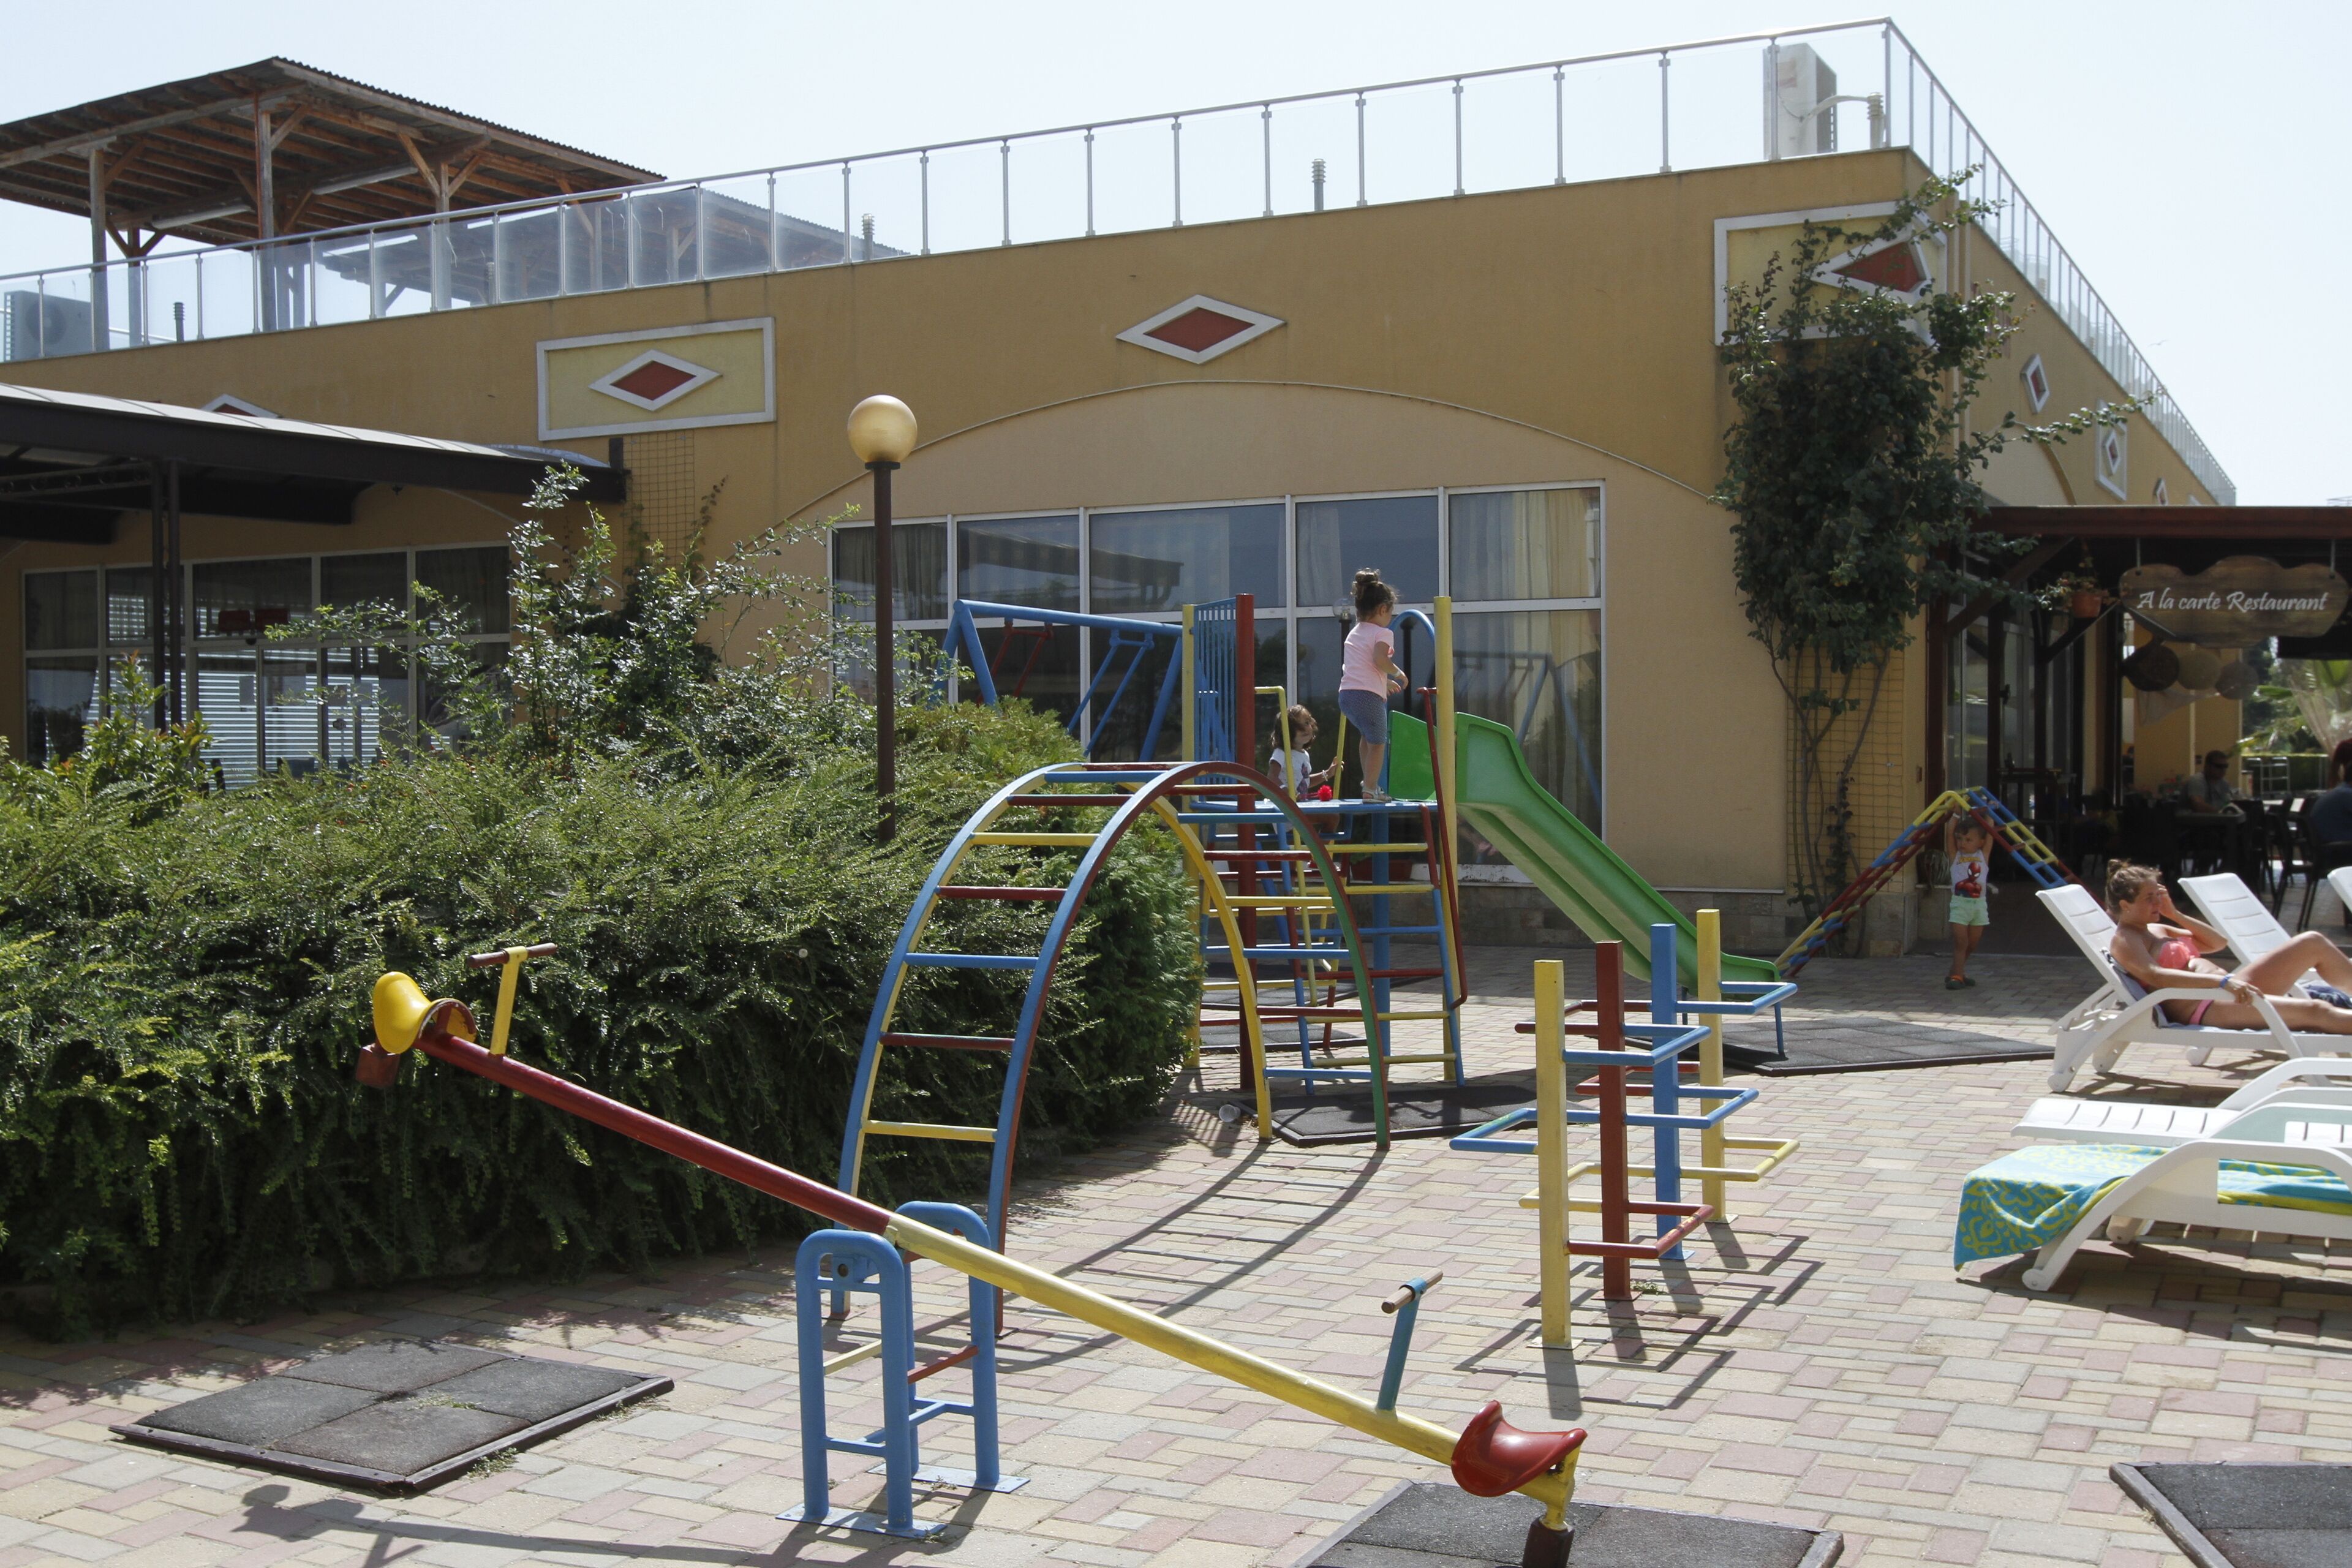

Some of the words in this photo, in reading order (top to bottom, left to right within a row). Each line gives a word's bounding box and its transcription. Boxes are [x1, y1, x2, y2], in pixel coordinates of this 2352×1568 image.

[2136, 591, 2154, 609] A
[2158, 587, 2174, 609] la
[2179, 592, 2221, 609] carte
[2226, 591, 2328, 612] Restaurant
